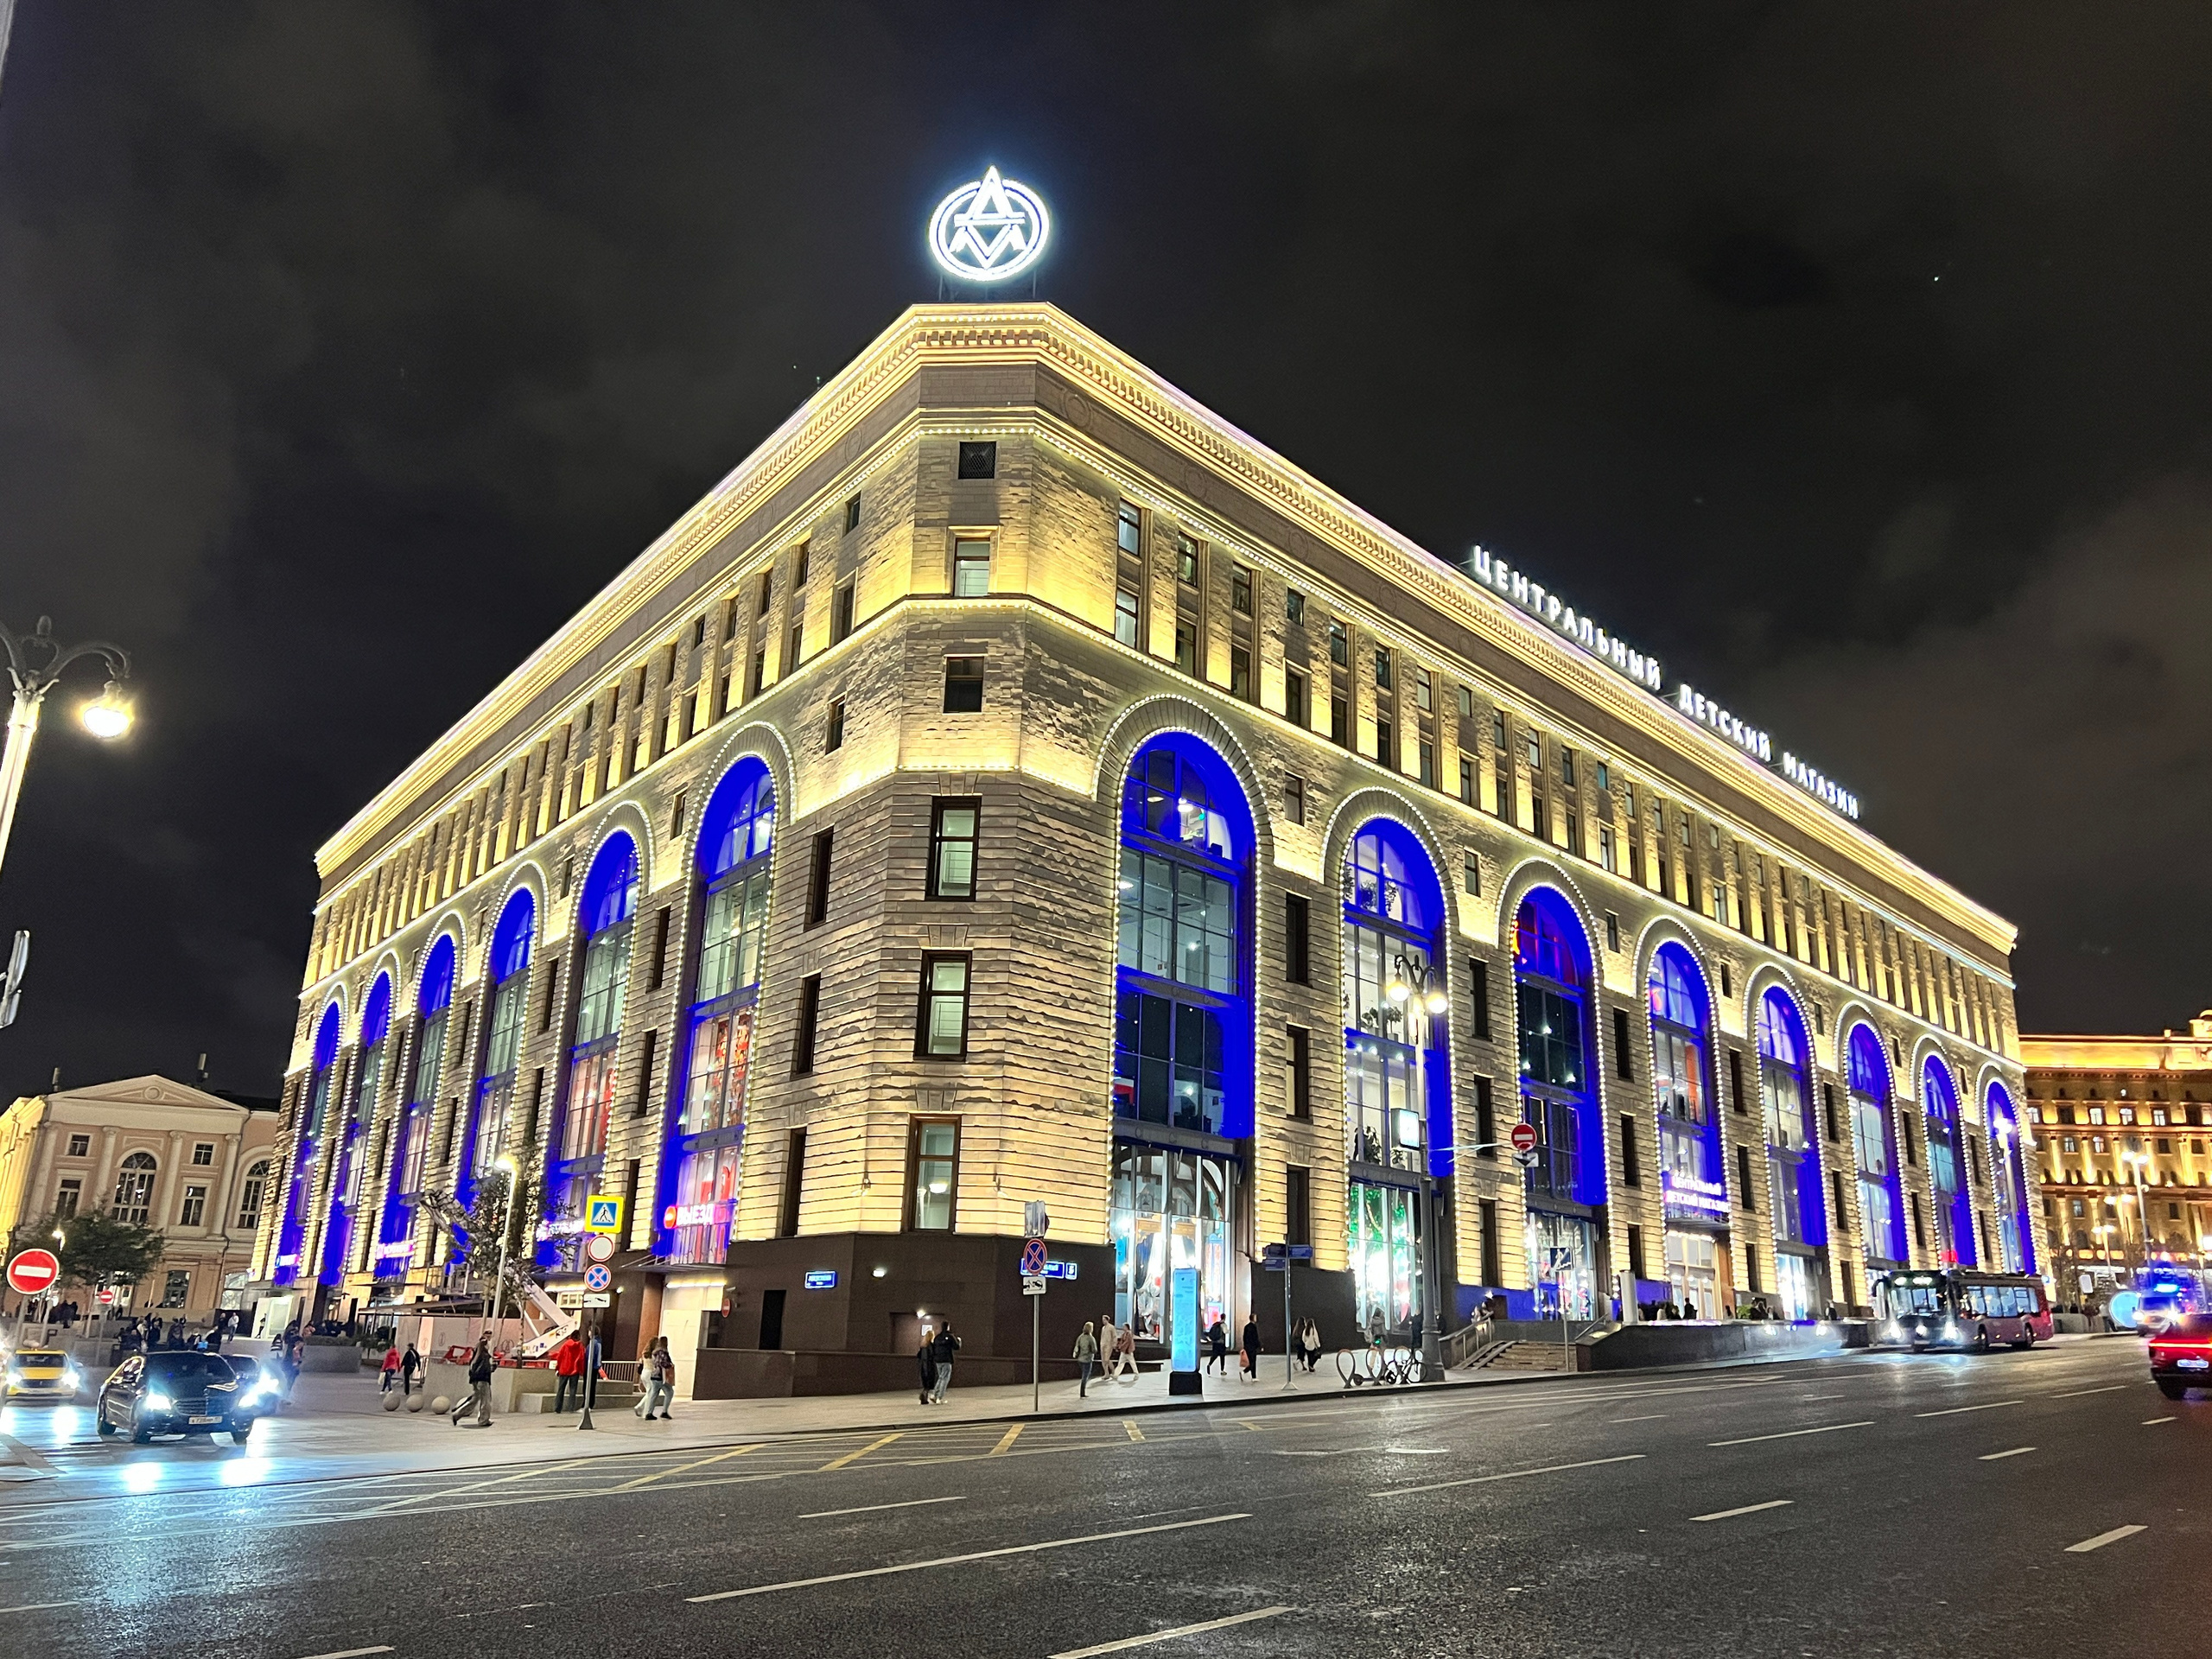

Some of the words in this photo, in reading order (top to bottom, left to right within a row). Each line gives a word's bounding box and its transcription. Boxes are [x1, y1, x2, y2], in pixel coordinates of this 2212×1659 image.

[1474, 544, 1661, 690] ЦЕНТРАЛЬНЫЙ
[1679, 683, 1771, 761] ДЕТСКИЙ
[1783, 752, 1859, 819] МАГАЗИН
[677, 1204, 715, 1225] ВЫЕЗД
